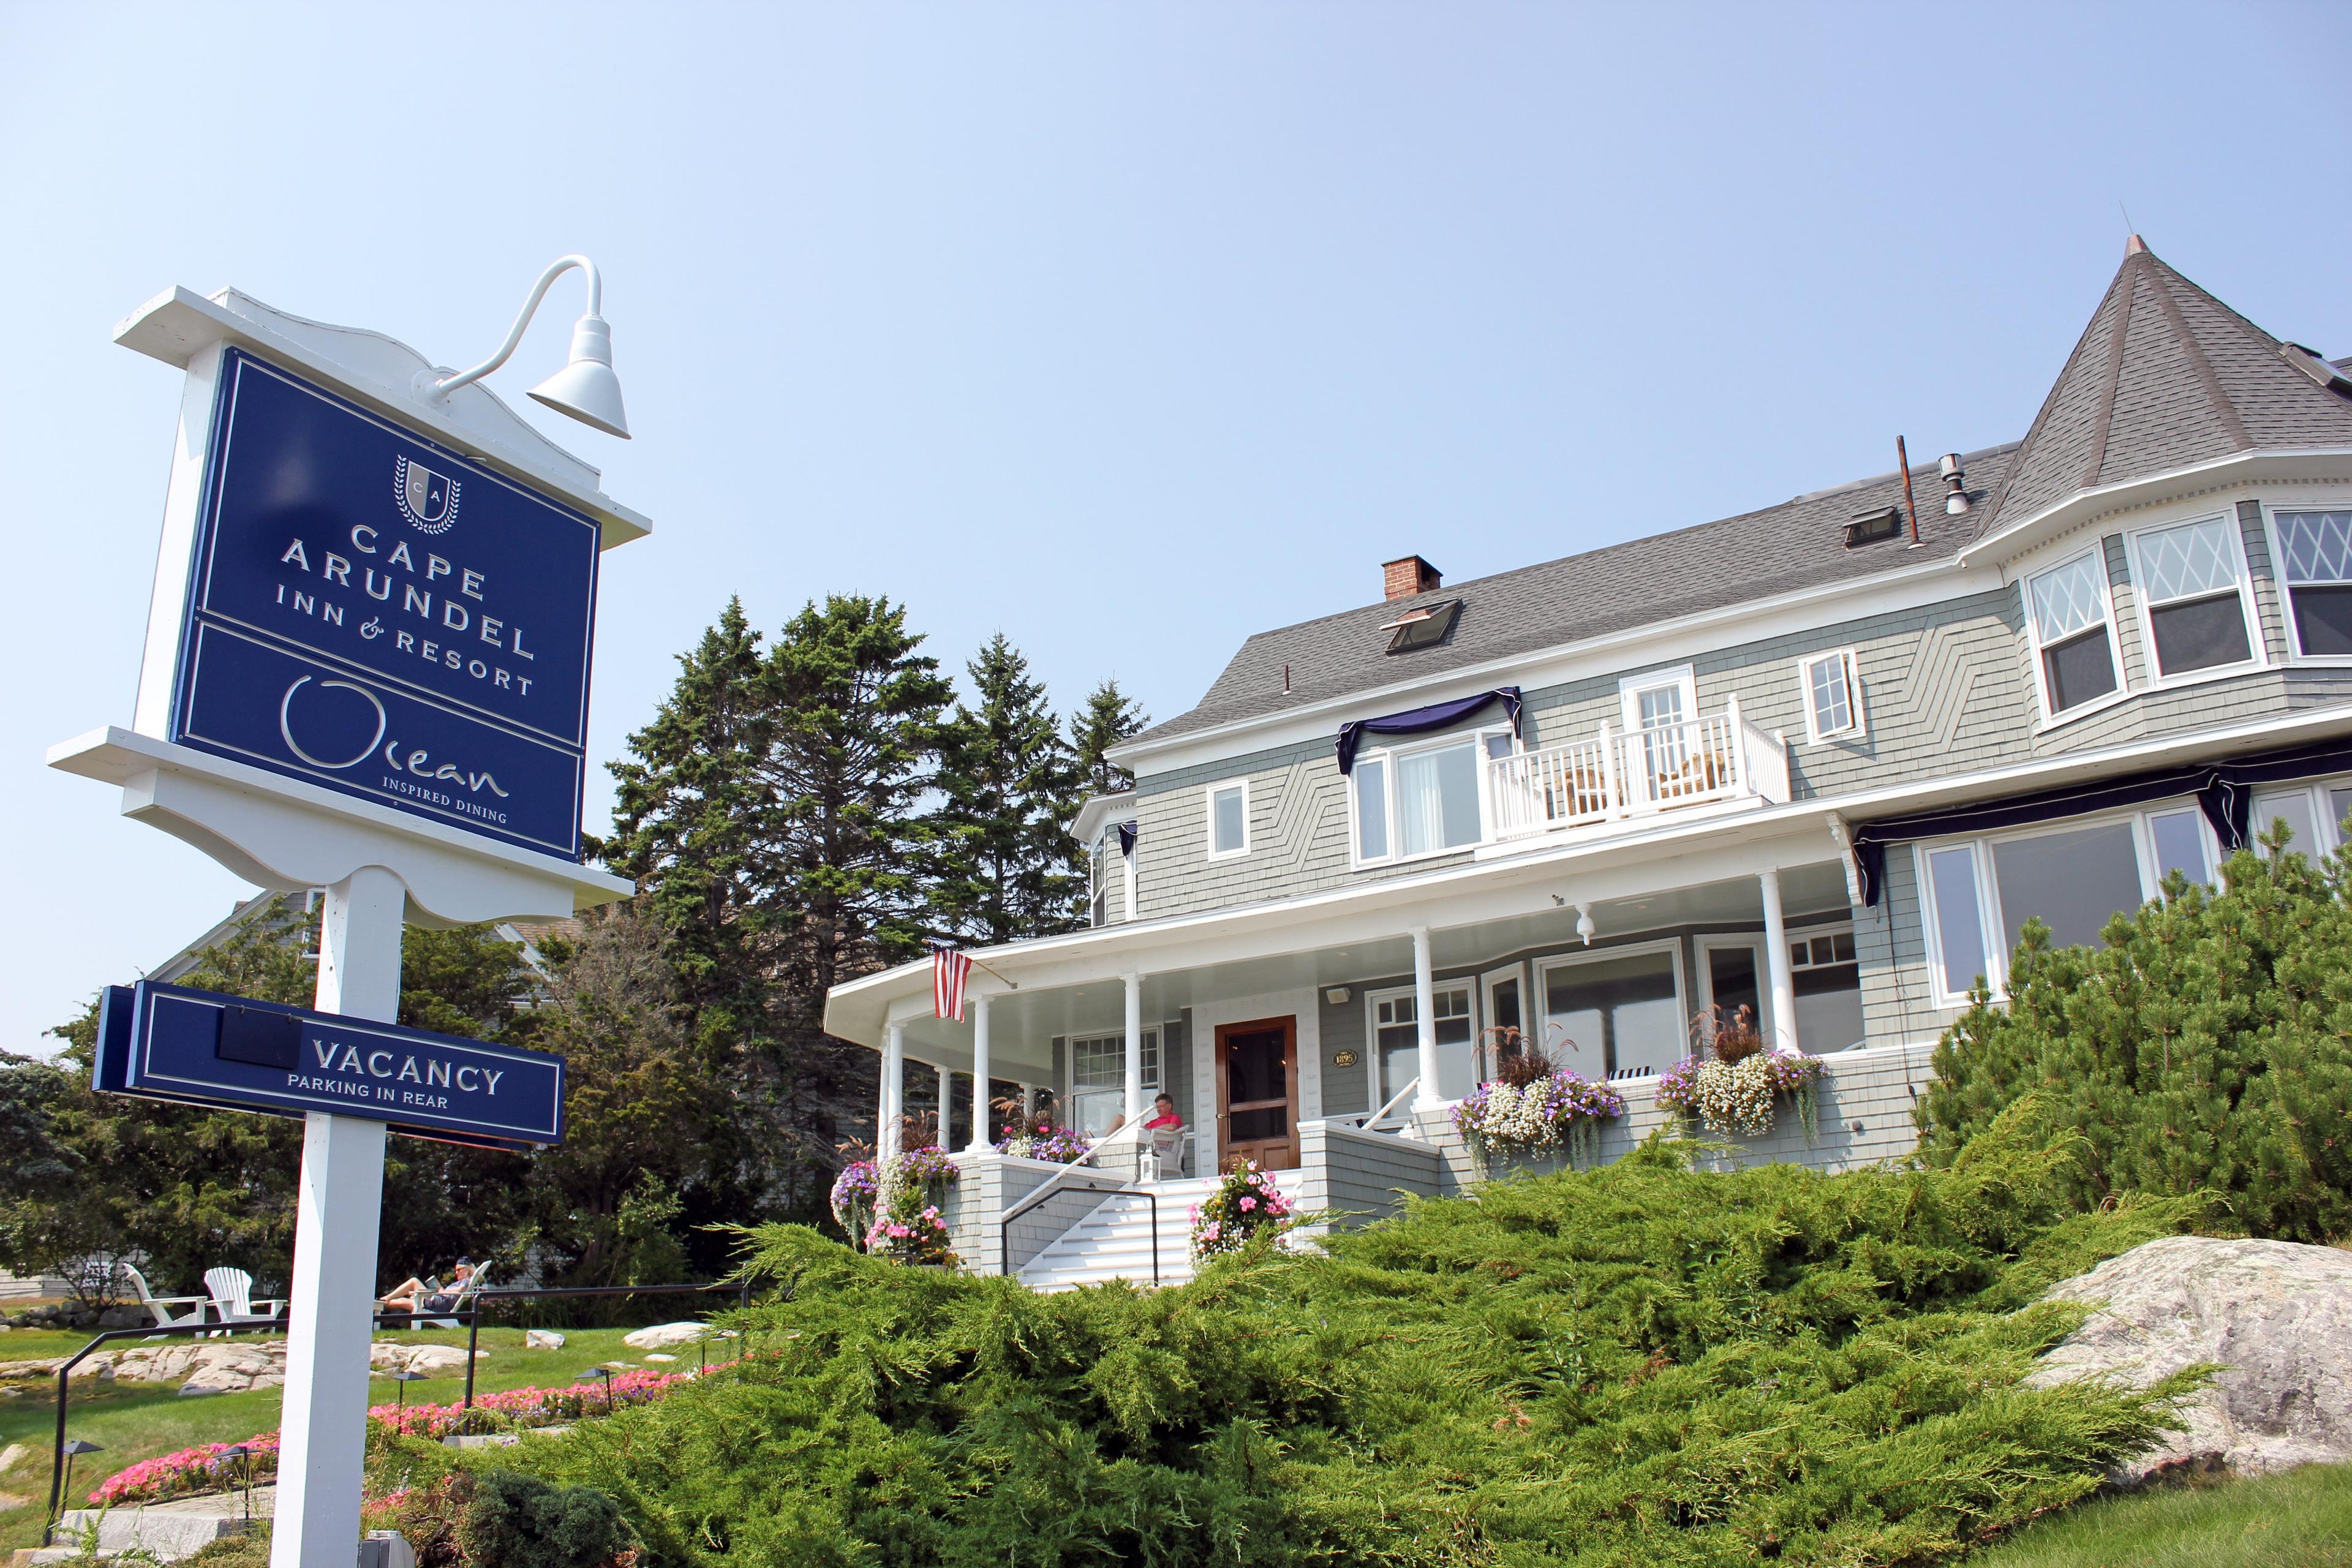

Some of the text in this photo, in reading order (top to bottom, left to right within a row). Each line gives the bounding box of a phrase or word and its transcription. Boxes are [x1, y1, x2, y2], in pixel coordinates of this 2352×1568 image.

[413, 482, 440, 502] C A
[351, 524, 485, 601] CAPE
[281, 538, 534, 660] ARUNDEL
[276, 584, 532, 696] INN & RESORT
[280, 675, 509, 797] Ocean
[382, 776, 507, 824] INSPIRED DINING
[312, 1039, 504, 1095] VACANCY
[1336, 1054, 1353, 1063] 1895
[287, 1073, 448, 1109] PARKING IN REAR
